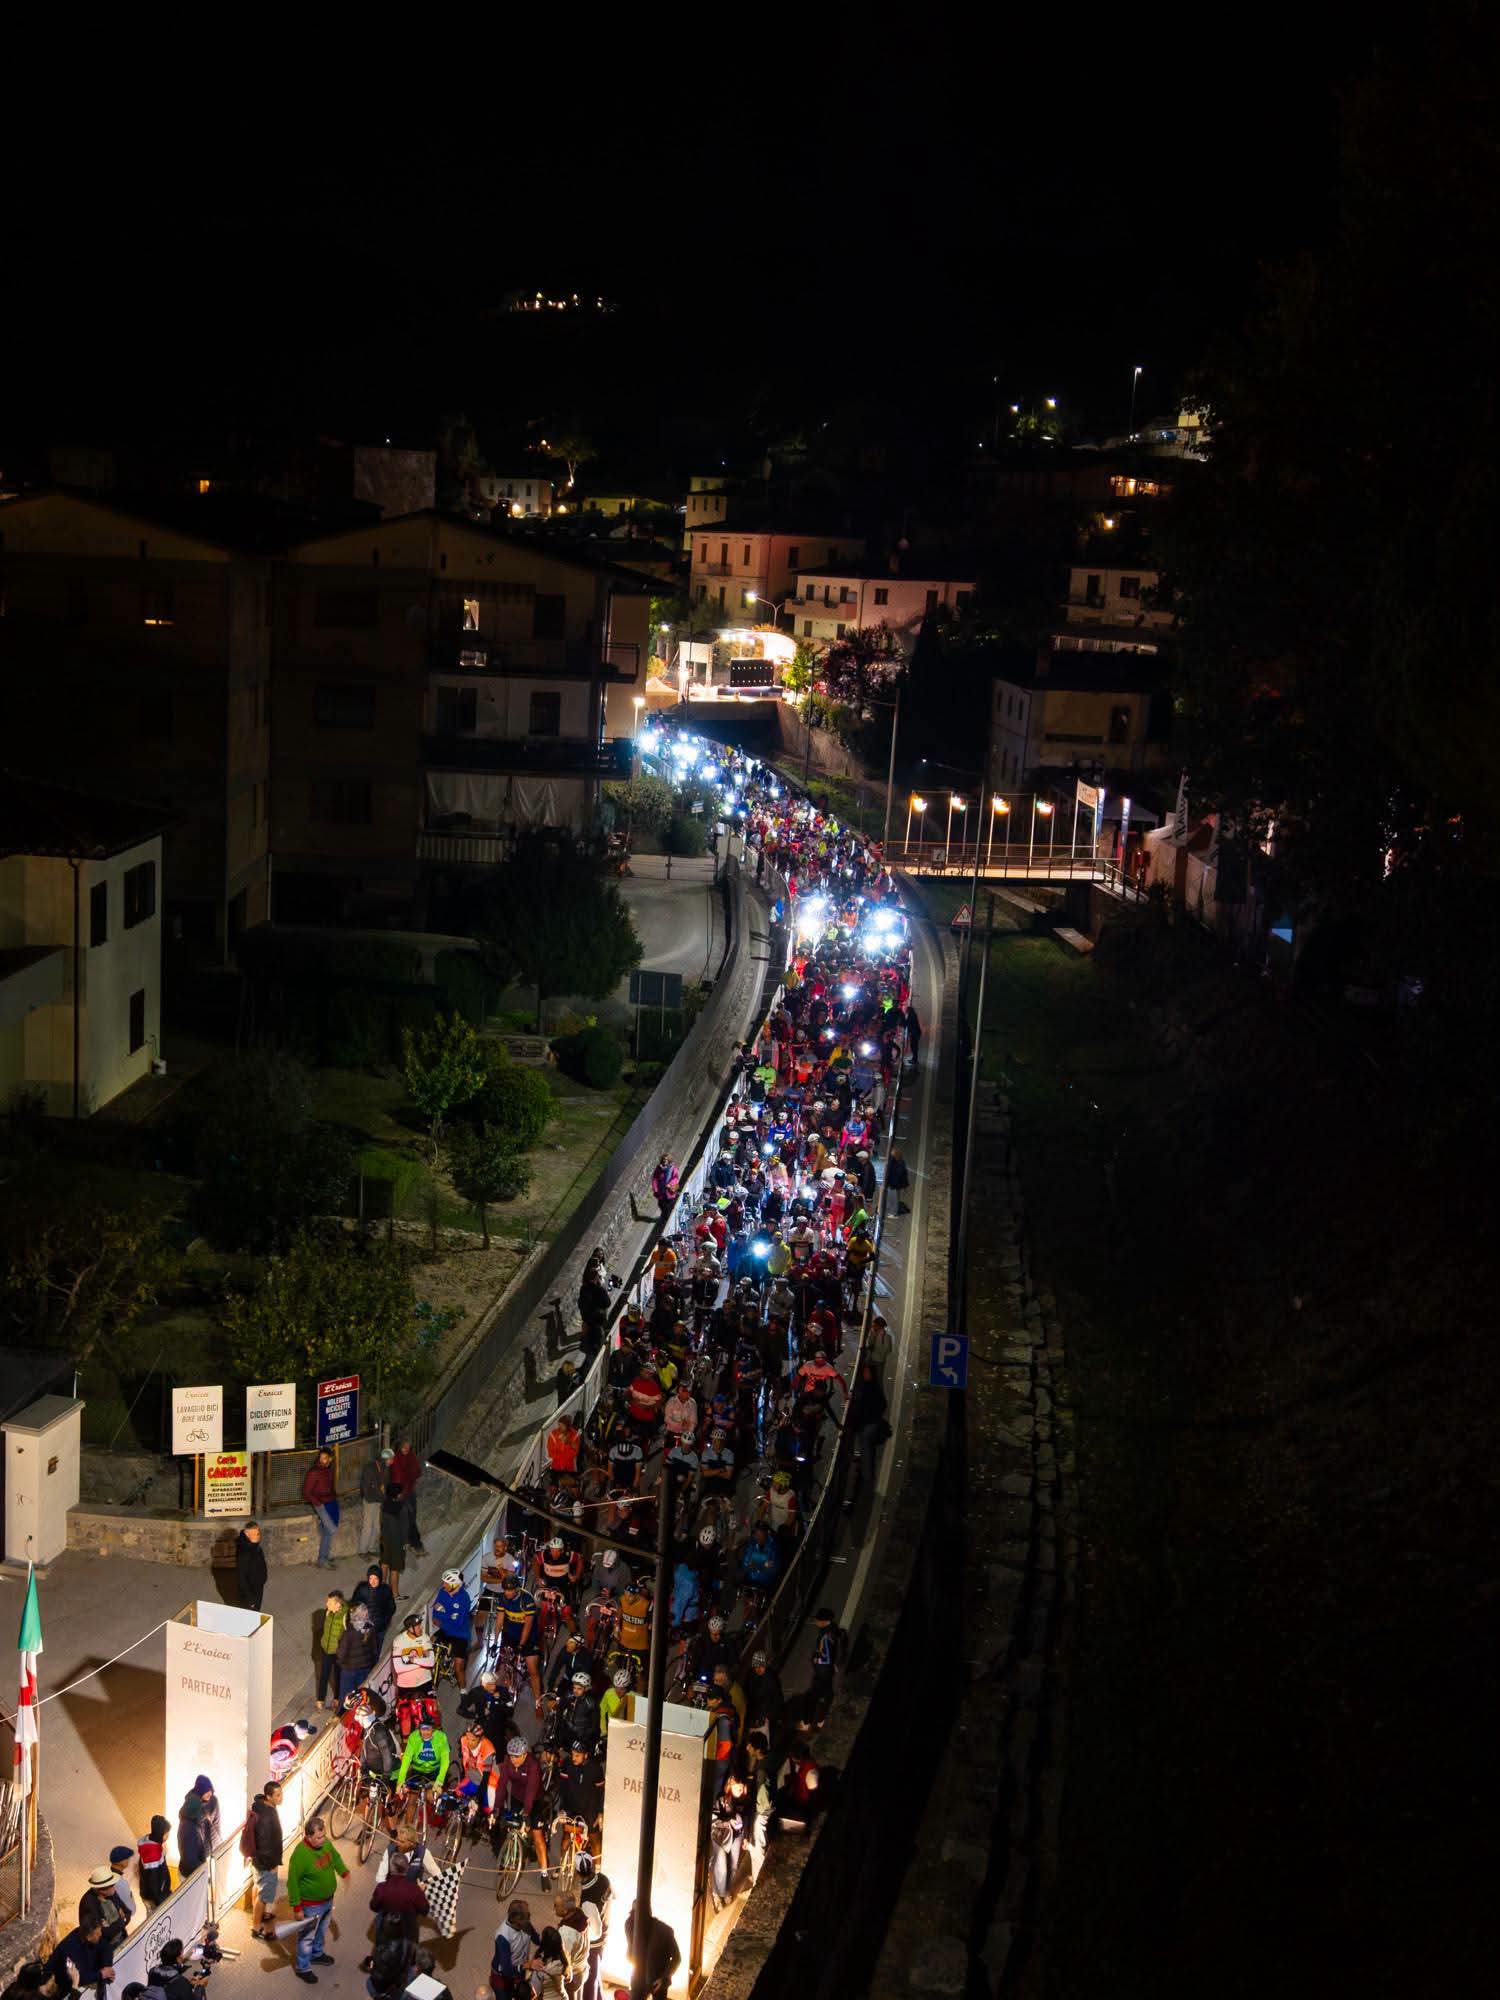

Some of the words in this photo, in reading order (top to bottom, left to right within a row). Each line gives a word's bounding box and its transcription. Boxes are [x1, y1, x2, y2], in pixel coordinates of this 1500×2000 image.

[938, 1338, 960, 1365] P
[176, 1404, 205, 1414] LAVAGGIO
[206, 1404, 219, 1412] BICI
[249, 1408, 292, 1419] CICLOFFICINA
[196, 1414, 214, 1422] WASH
[253, 1421, 289, 1431] WORKSHOP
[183, 1640, 232, 1660] L'Eroica
[181, 1676, 232, 1701] PARTENZA
